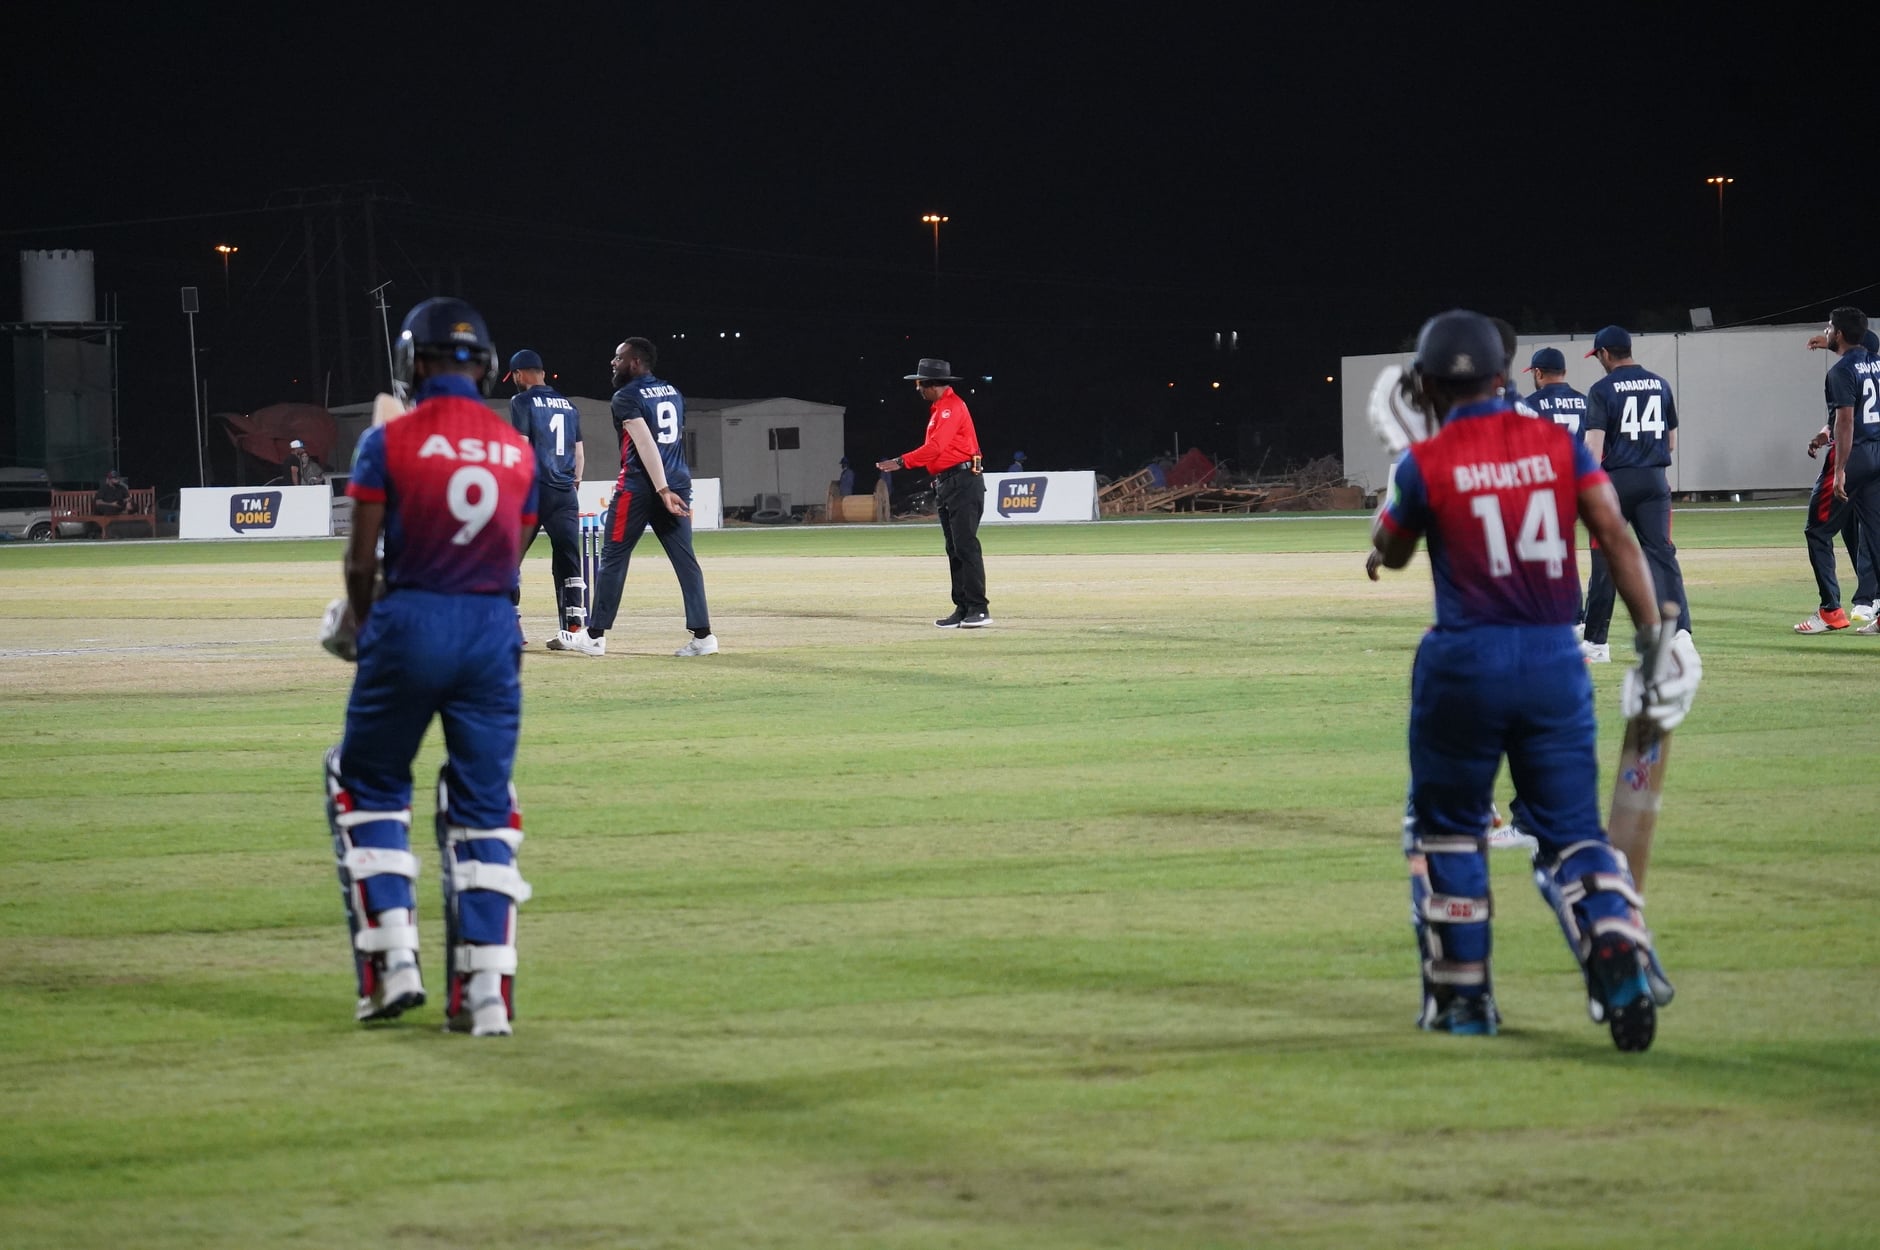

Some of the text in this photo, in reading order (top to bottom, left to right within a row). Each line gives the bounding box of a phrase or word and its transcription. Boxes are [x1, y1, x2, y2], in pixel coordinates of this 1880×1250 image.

[532, 397, 573, 410] M. PATEL
[1539, 398, 1553, 410] N.
[1555, 397, 1587, 409] PATEL
[1613, 379, 1662, 393] PARADKAR
[1862, 378, 1880, 424] 2
[549, 413, 565, 456] 1
[656, 401, 679, 444] 9
[1620, 395, 1665, 441] 44
[417, 433, 522, 468] ASIF
[1453, 454, 1557, 493] BHURTEL
[236, 511, 272, 524] DONE
[446, 465, 499, 545] 9
[1003, 497, 1037, 508] DONE
[1470, 488, 1568, 579] 14
